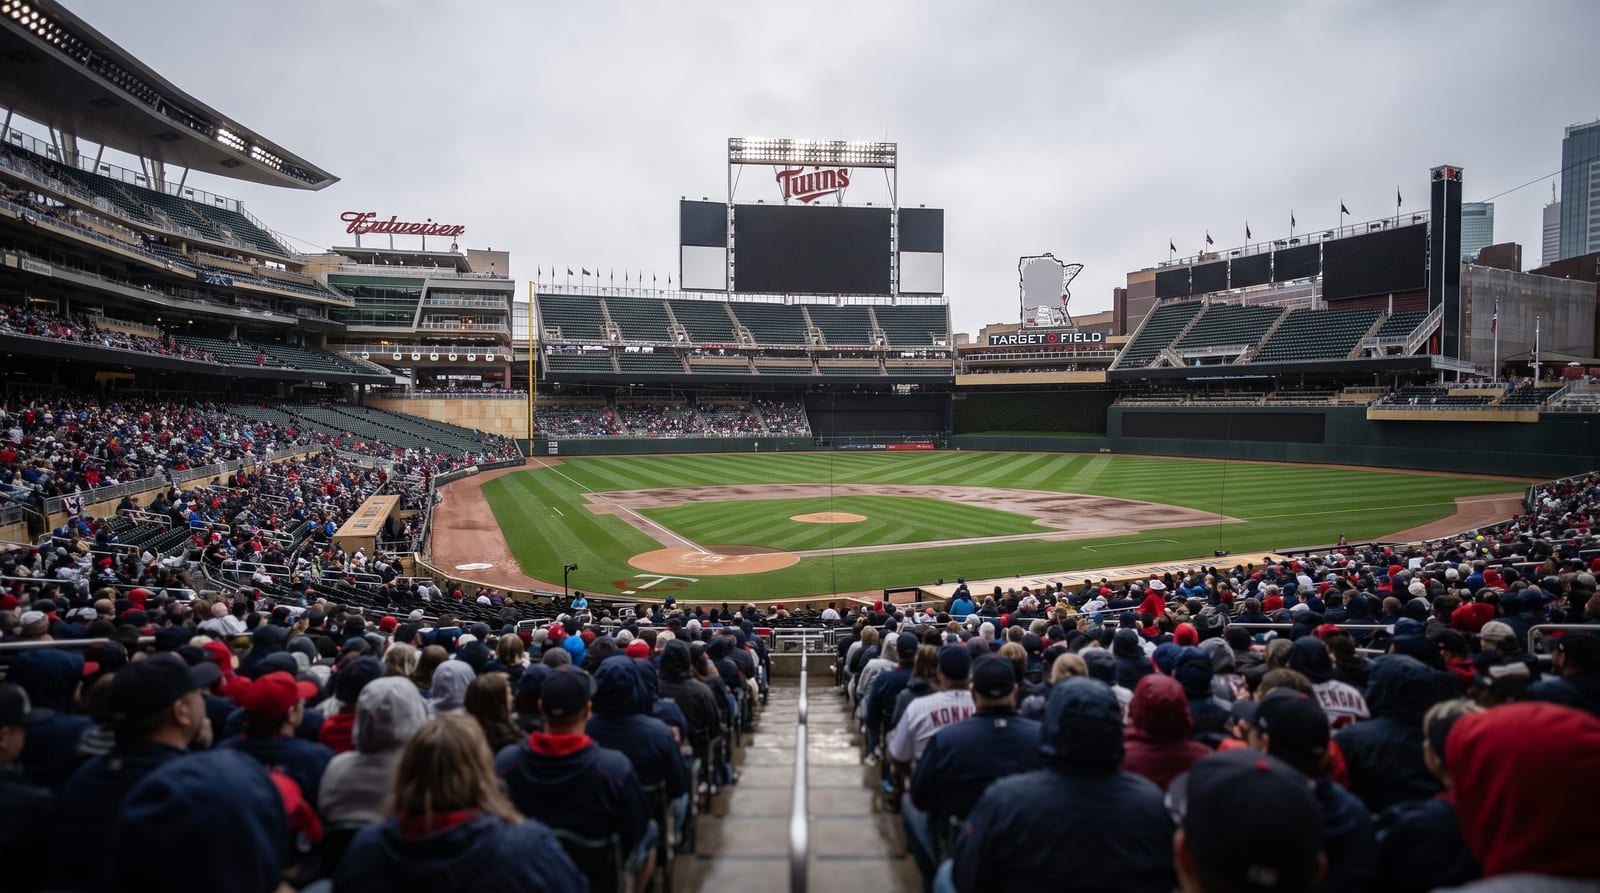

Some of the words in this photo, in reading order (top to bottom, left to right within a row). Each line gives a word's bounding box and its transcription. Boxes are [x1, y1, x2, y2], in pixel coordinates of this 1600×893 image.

[776, 165, 850, 203] Twins
[340, 211, 465, 236] Budweiser
[990, 334, 1046, 345] TARGET
[1060, 332, 1102, 343] FIELD
